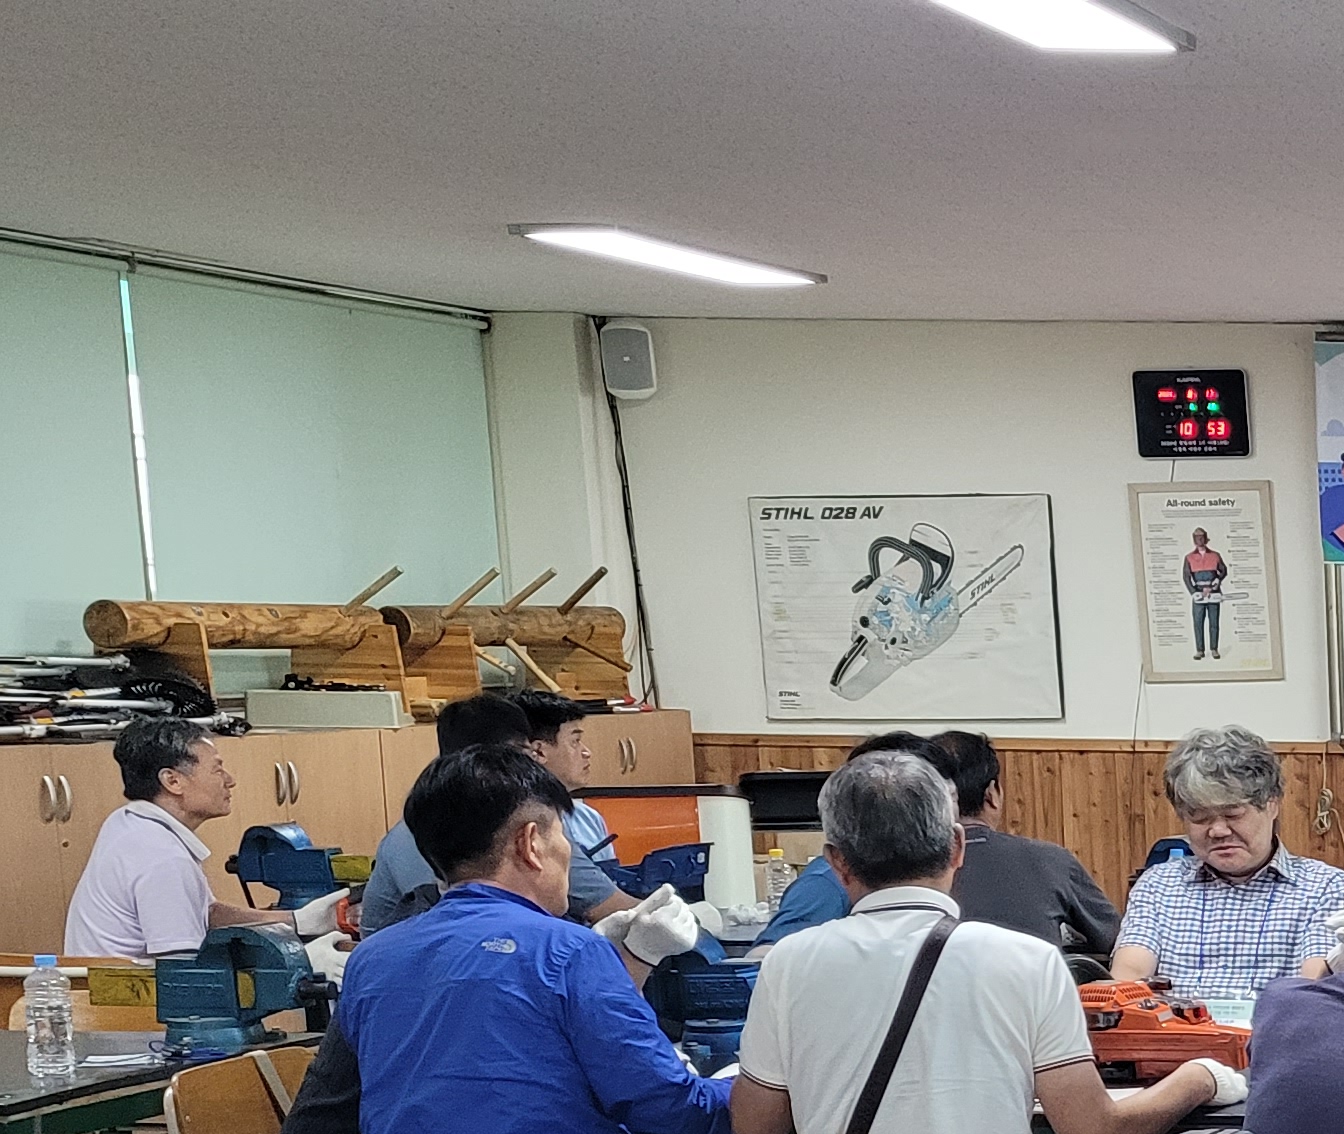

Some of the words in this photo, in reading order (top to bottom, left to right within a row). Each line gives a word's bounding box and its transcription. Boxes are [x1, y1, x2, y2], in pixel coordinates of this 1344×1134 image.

[1207, 421, 1226, 436] 53
[1165, 498, 1206, 508] All-round
[1208, 497, 1236, 508] safety
[759, 506, 815, 520] STIHL
[820, 506, 858, 520] 028
[859, 505, 884, 520] AV
[969, 573, 996, 600] STIHL
